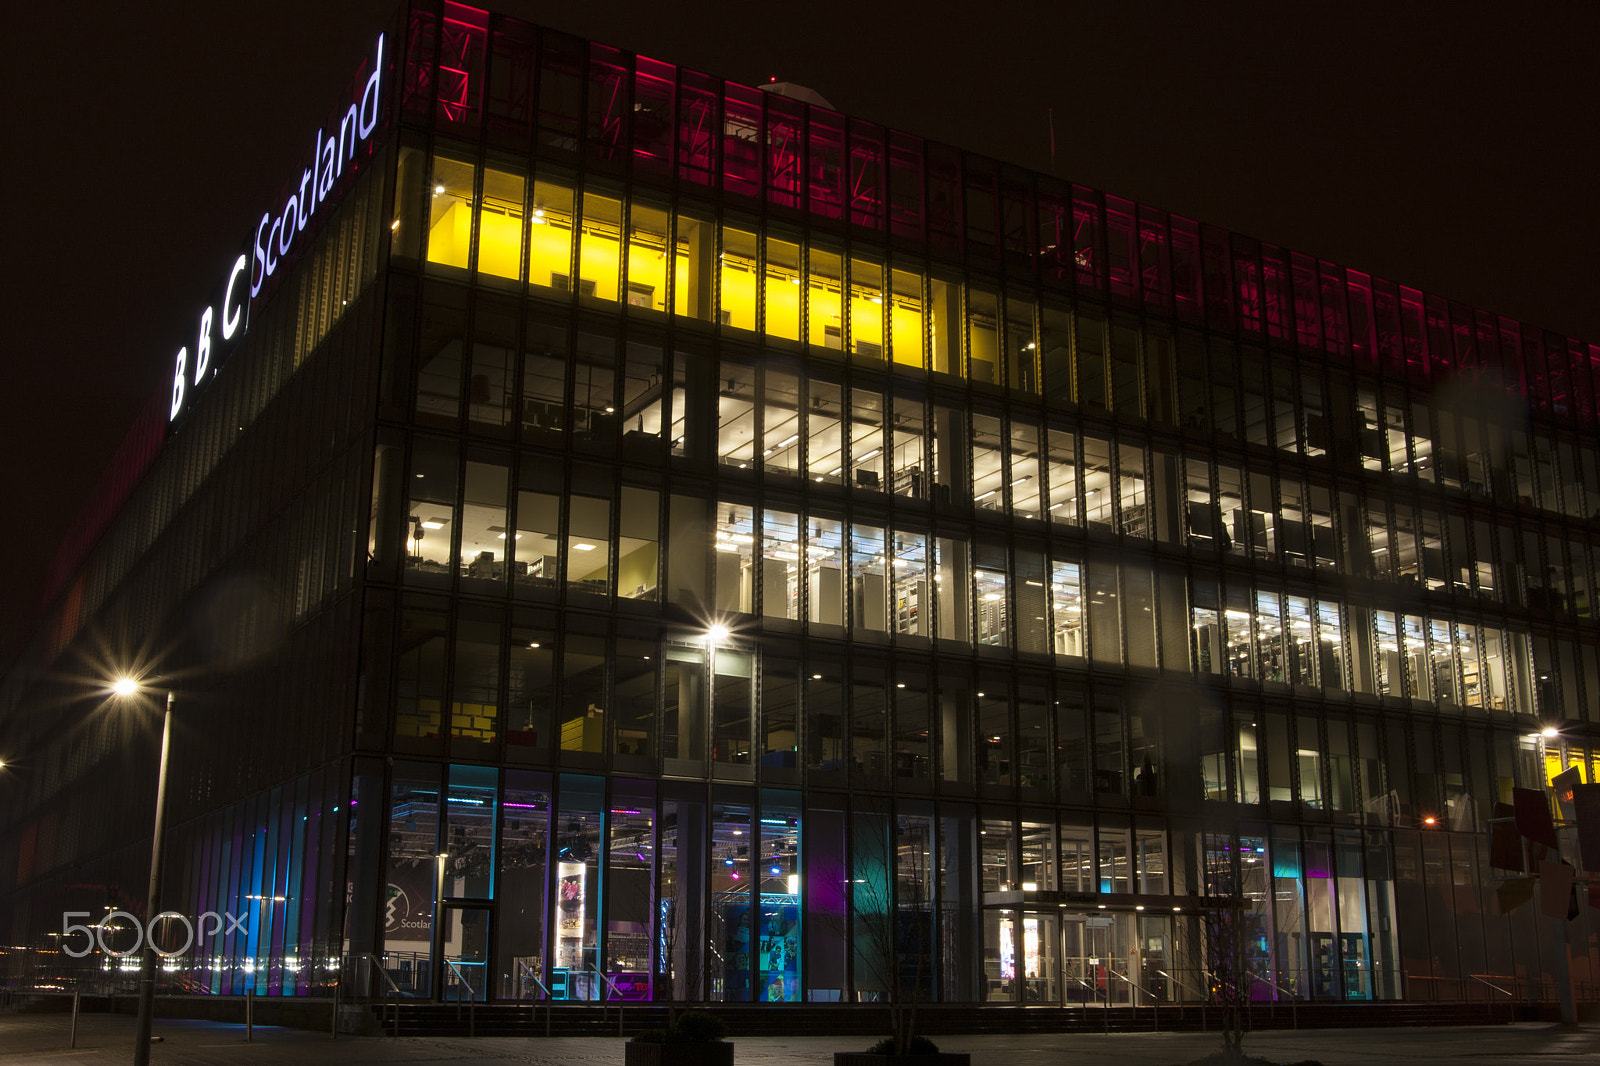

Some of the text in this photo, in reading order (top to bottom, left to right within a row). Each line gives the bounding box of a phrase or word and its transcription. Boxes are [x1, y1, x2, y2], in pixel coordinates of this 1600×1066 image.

[169, 31, 385, 421] BBC Scotland
[401, 919, 432, 928] Scotlan
